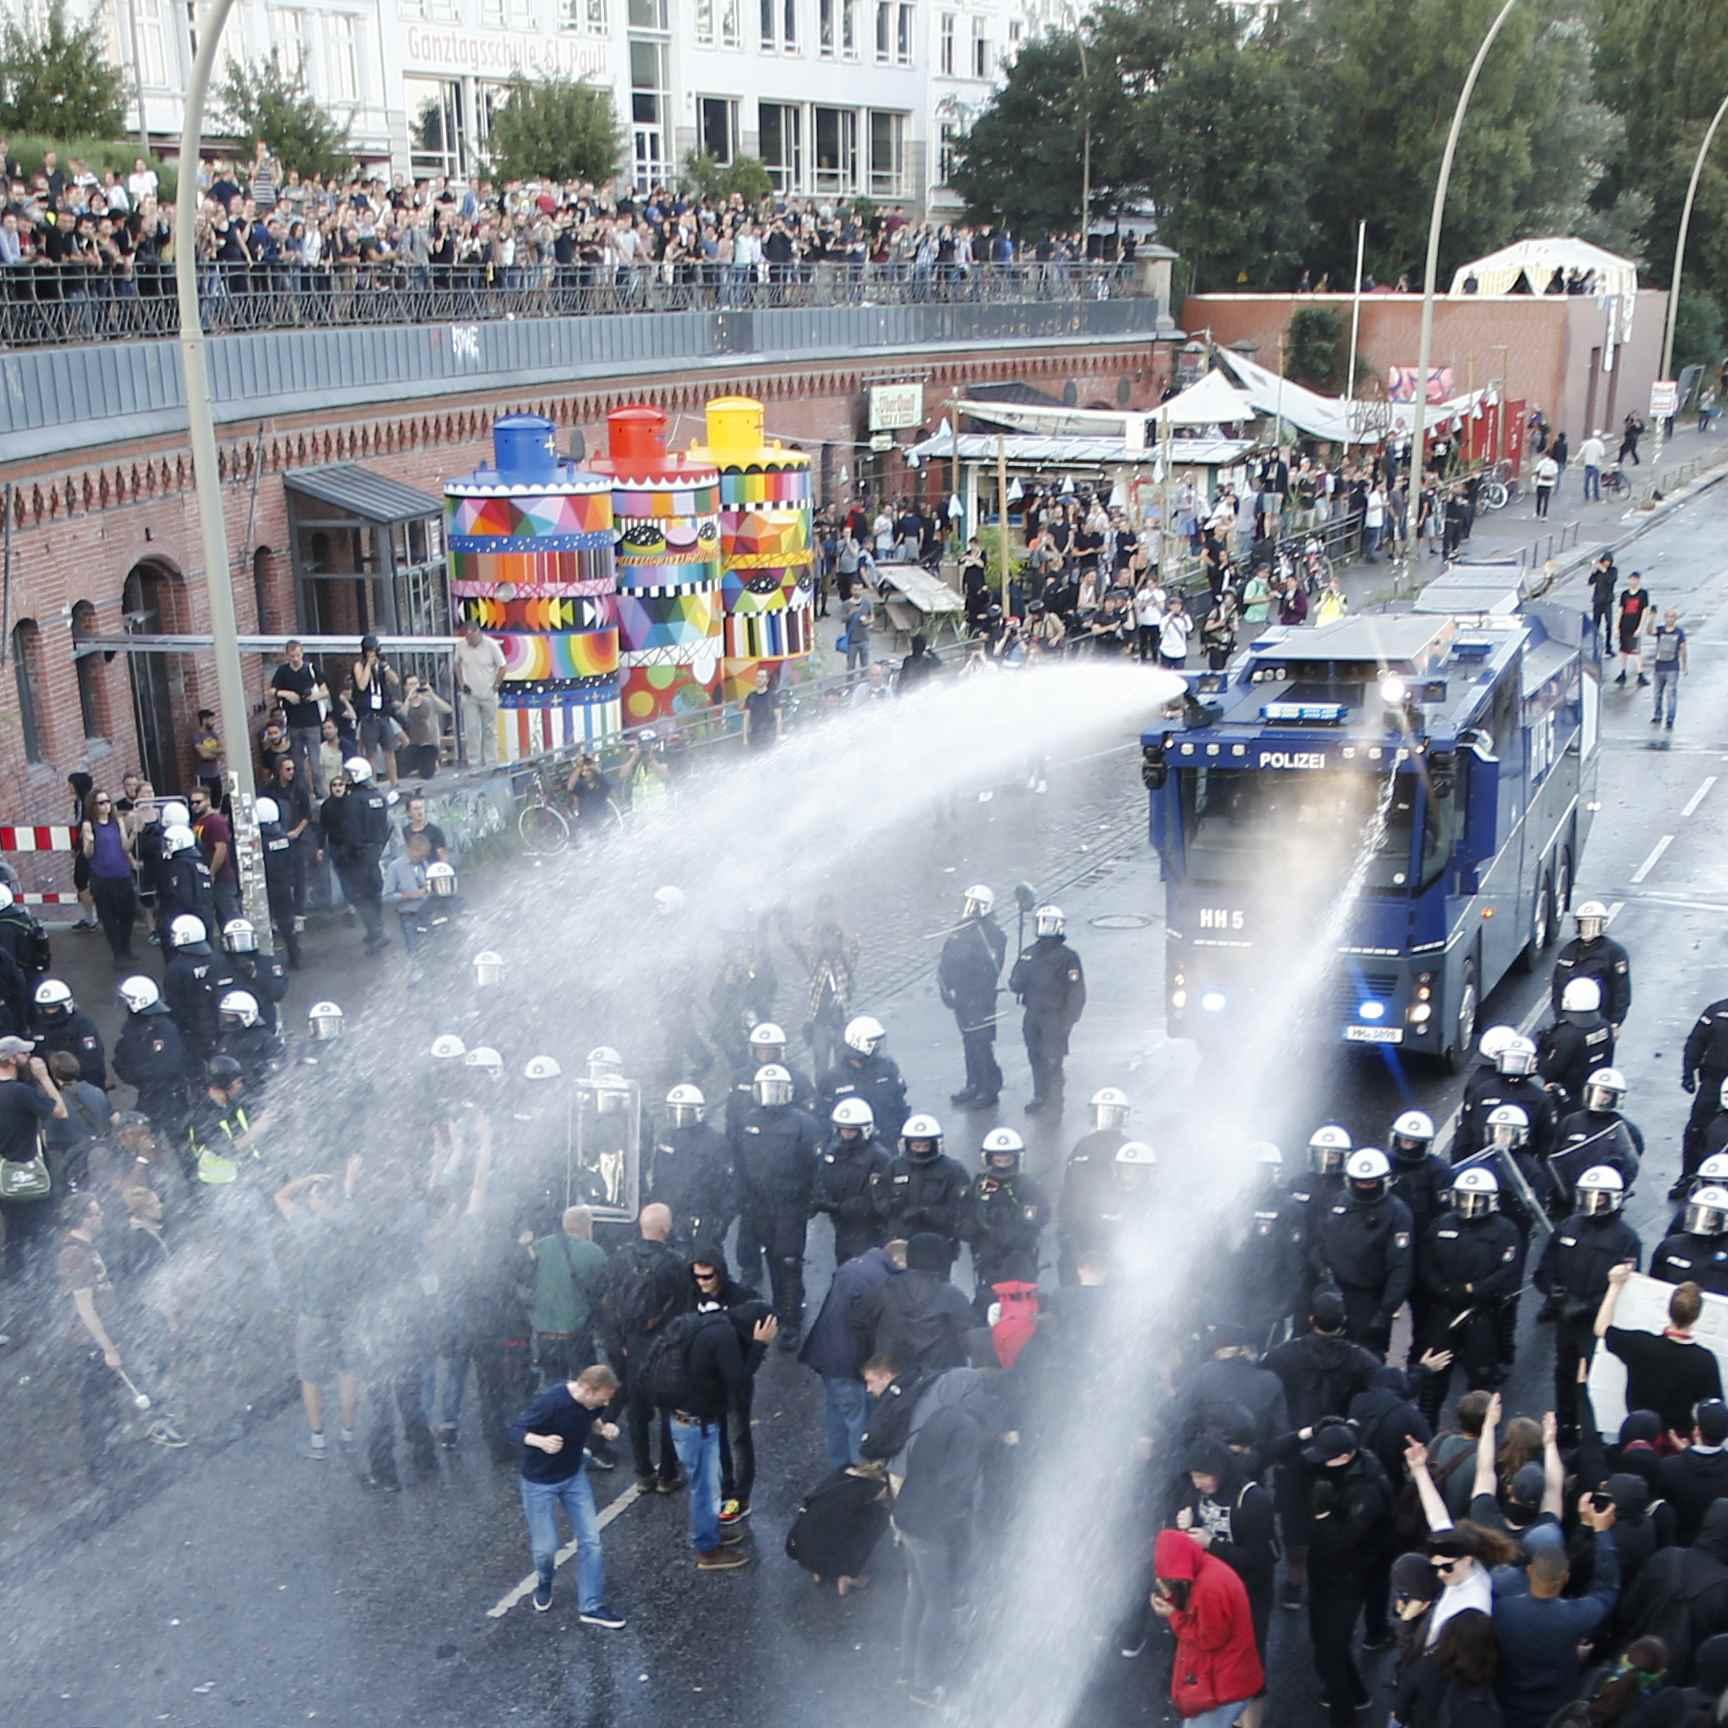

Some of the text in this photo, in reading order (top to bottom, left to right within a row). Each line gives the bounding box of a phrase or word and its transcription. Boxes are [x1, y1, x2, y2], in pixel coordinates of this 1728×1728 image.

[1259, 752, 1325, 769] POLIZEI
[1200, 909, 1245, 930] HH 5
